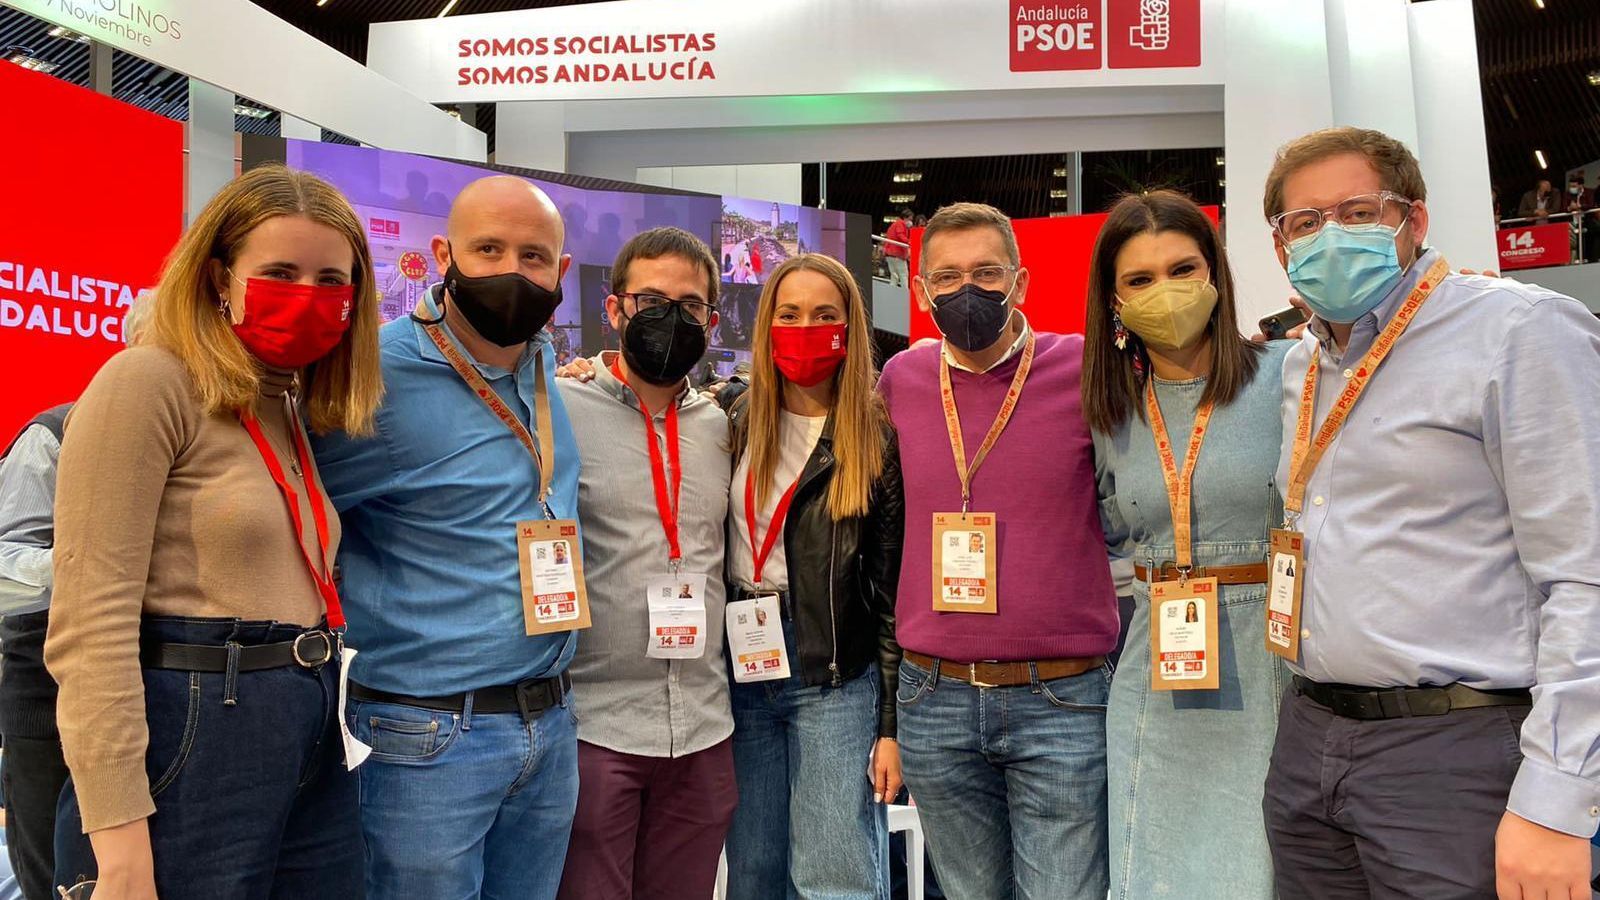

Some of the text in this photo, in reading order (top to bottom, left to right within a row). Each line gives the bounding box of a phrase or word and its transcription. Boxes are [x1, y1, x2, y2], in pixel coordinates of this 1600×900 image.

[93, 0, 182, 40] OLINOS
[1016, 4, 1088, 21] Andalucía
[60, 0, 152, 47] Noviembre
[458, 33, 716, 57] SOMOS SOCIALISTAS
[1017, 22, 1094, 51] PSOE
[458, 57, 716, 85] SOMOS ANDALUCÍA
[1506, 231, 1535, 249] 14
[1501, 247, 1545, 257] CONGRESO
[0, 262, 150, 309] CIALISTA
[949, 587, 961, 595] 14
[538, 605, 552, 616] 14
[661, 636, 672, 645] 14
[745, 662, 757, 671] 14
[1164, 662, 1177, 672] 14
